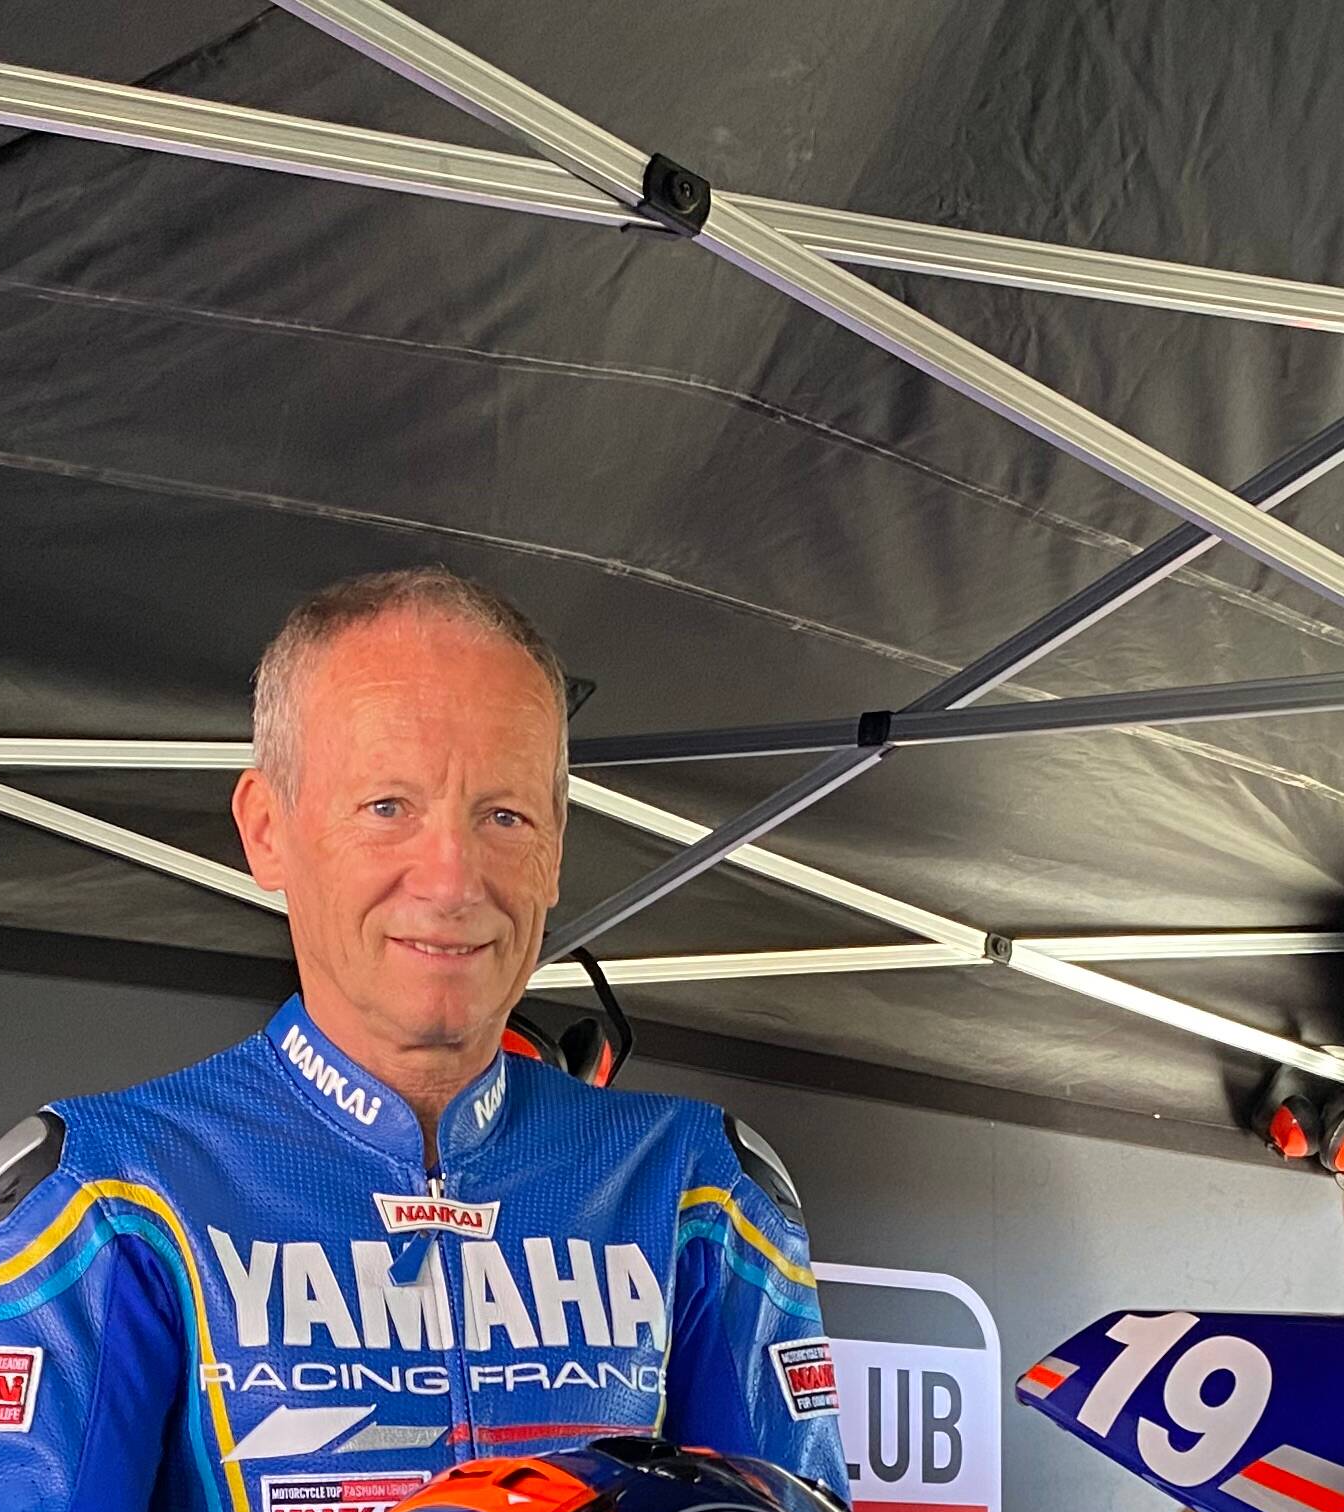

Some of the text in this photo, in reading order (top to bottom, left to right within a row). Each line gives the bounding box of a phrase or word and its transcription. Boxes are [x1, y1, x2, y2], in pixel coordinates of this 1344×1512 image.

[207, 1224, 666, 1353] YAMAHA
[199, 1361, 450, 1396] RACING
[847, 1366, 962, 1484] UB
[1075, 1311, 1273, 1488] 19
[271, 1486, 326, 1500] MOTORCYCLE
[326, 1486, 342, 1499] TOP
[343, 1484, 386, 1498] FASHION
